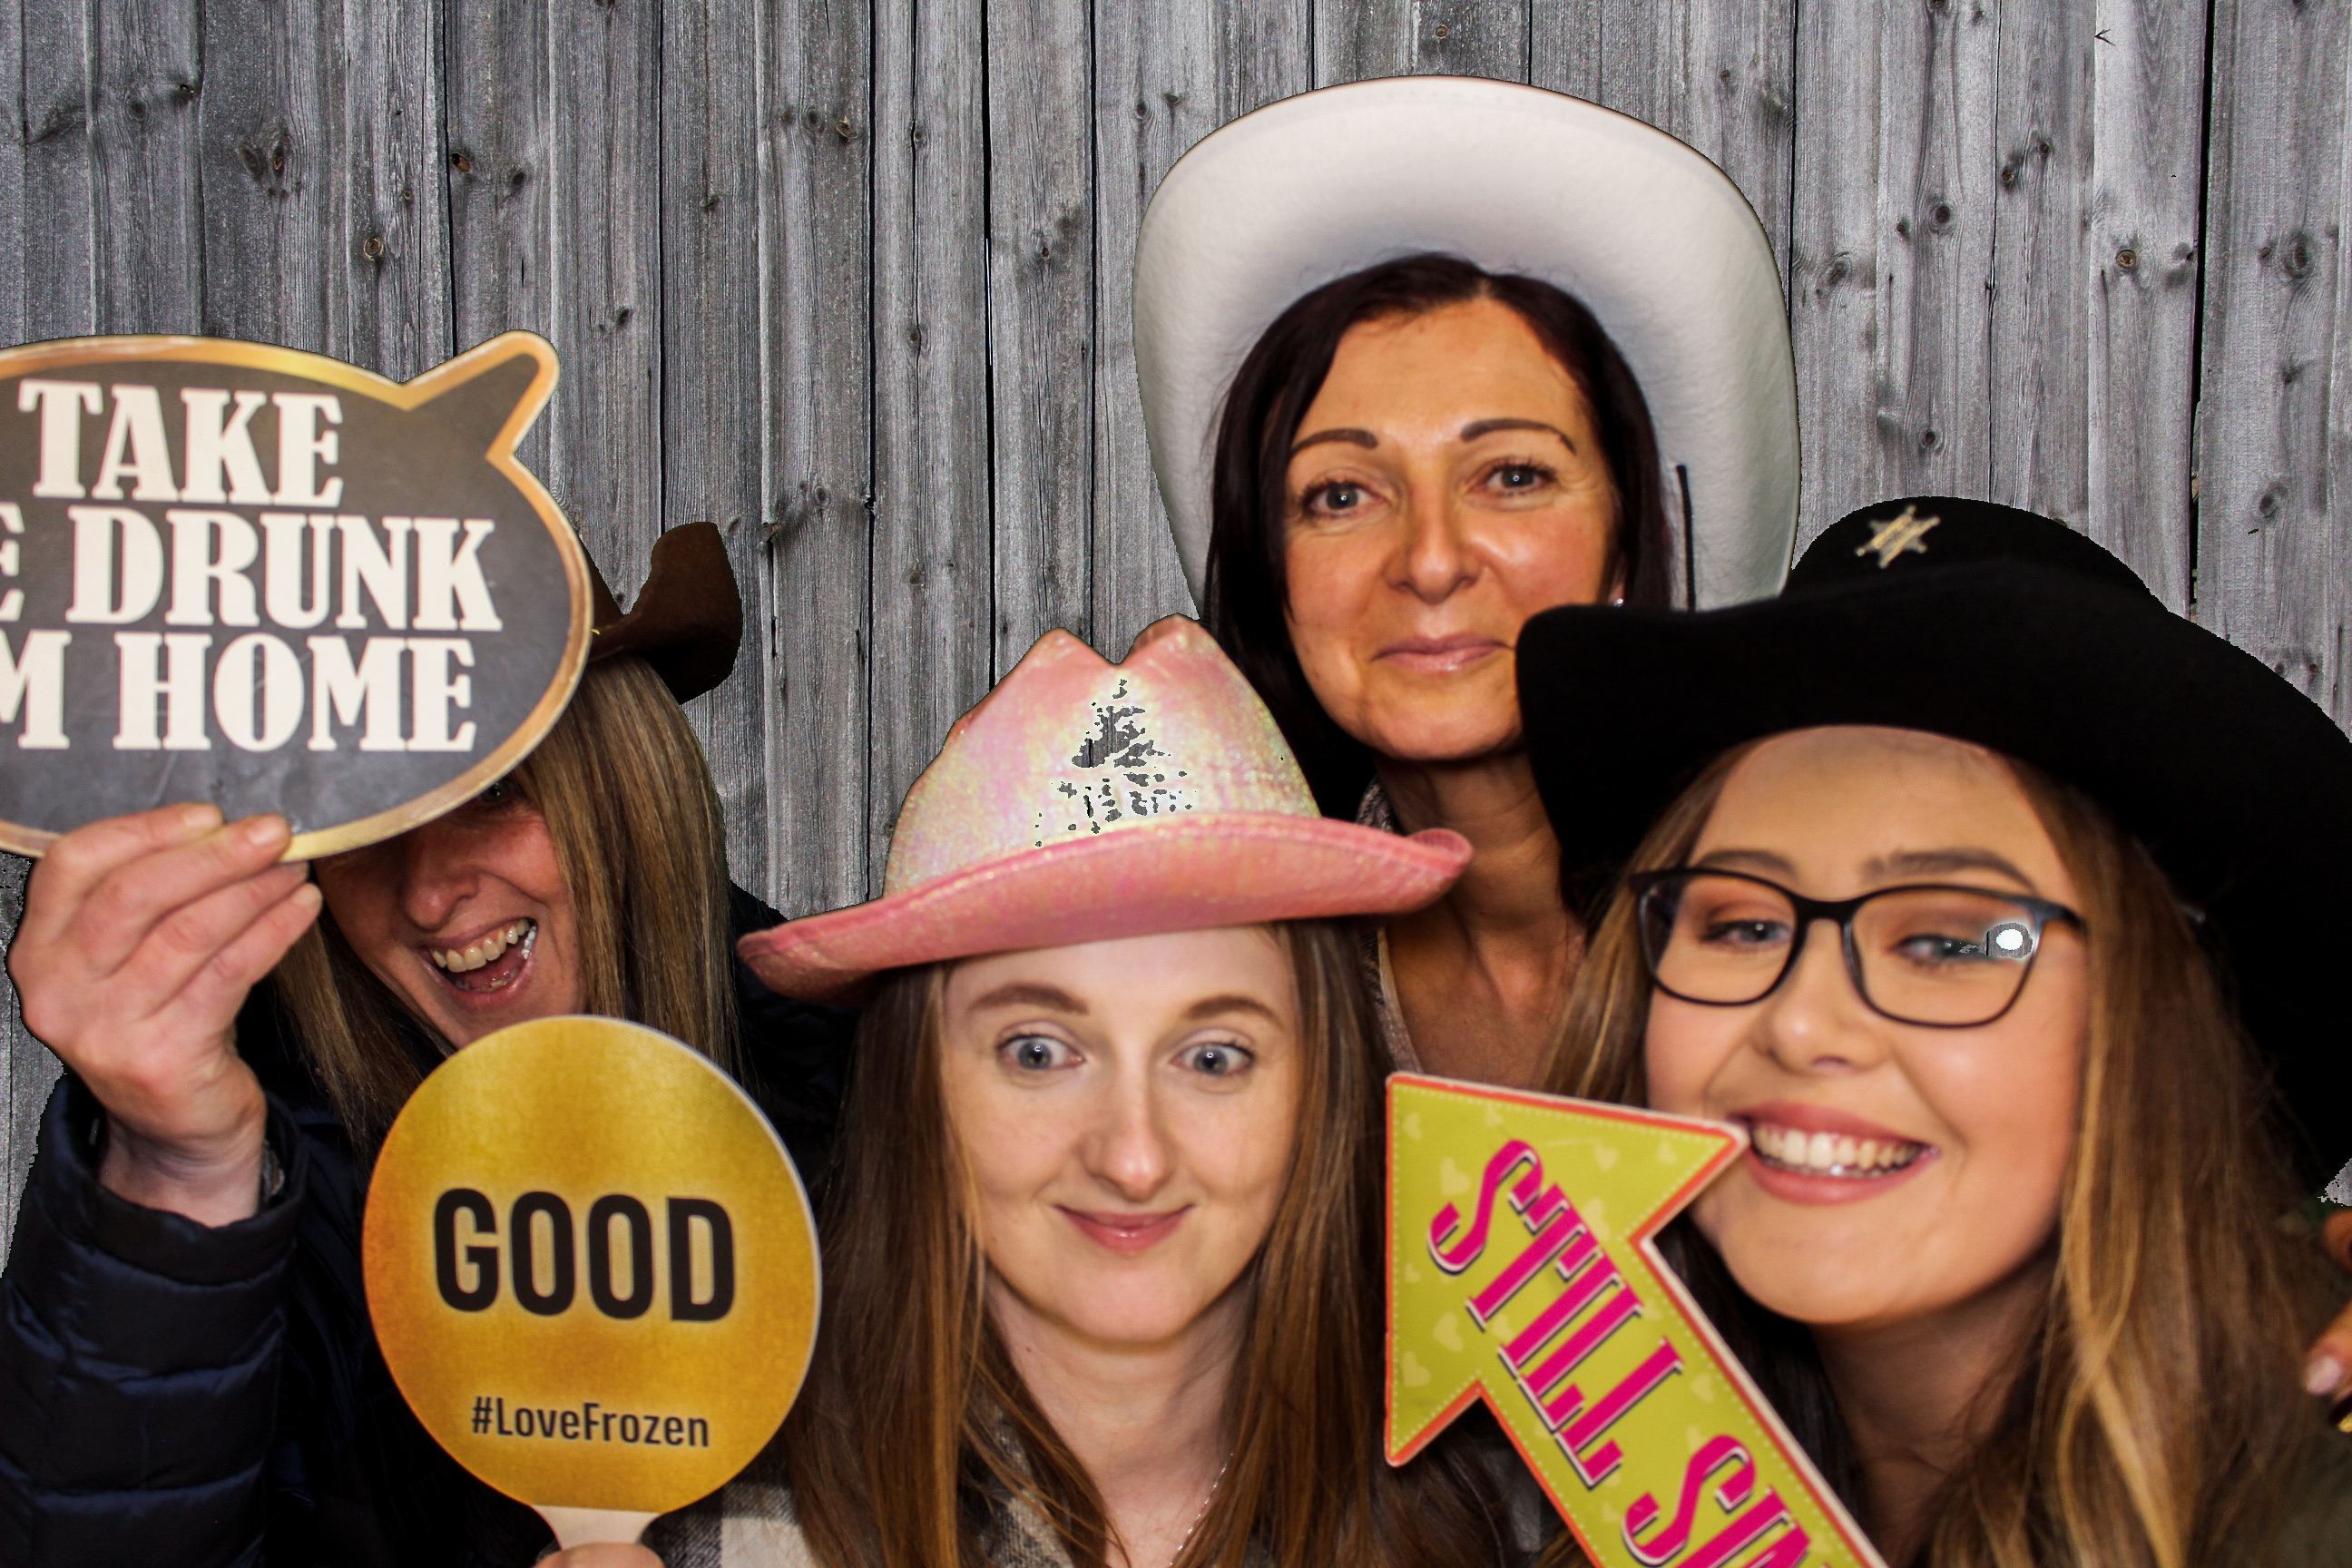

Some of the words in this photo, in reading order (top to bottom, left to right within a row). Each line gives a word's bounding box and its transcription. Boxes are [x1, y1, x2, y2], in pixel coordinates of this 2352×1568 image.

[18, 379, 344, 506] TAKE
[65, 505, 503, 631] DRUNK
[113, 631, 476, 752] HOME
[434, 1188, 736, 1323] GOOD
[1427, 1140, 1685, 1489] STILL
[471, 1396, 710, 1447] #LoveFrozen
